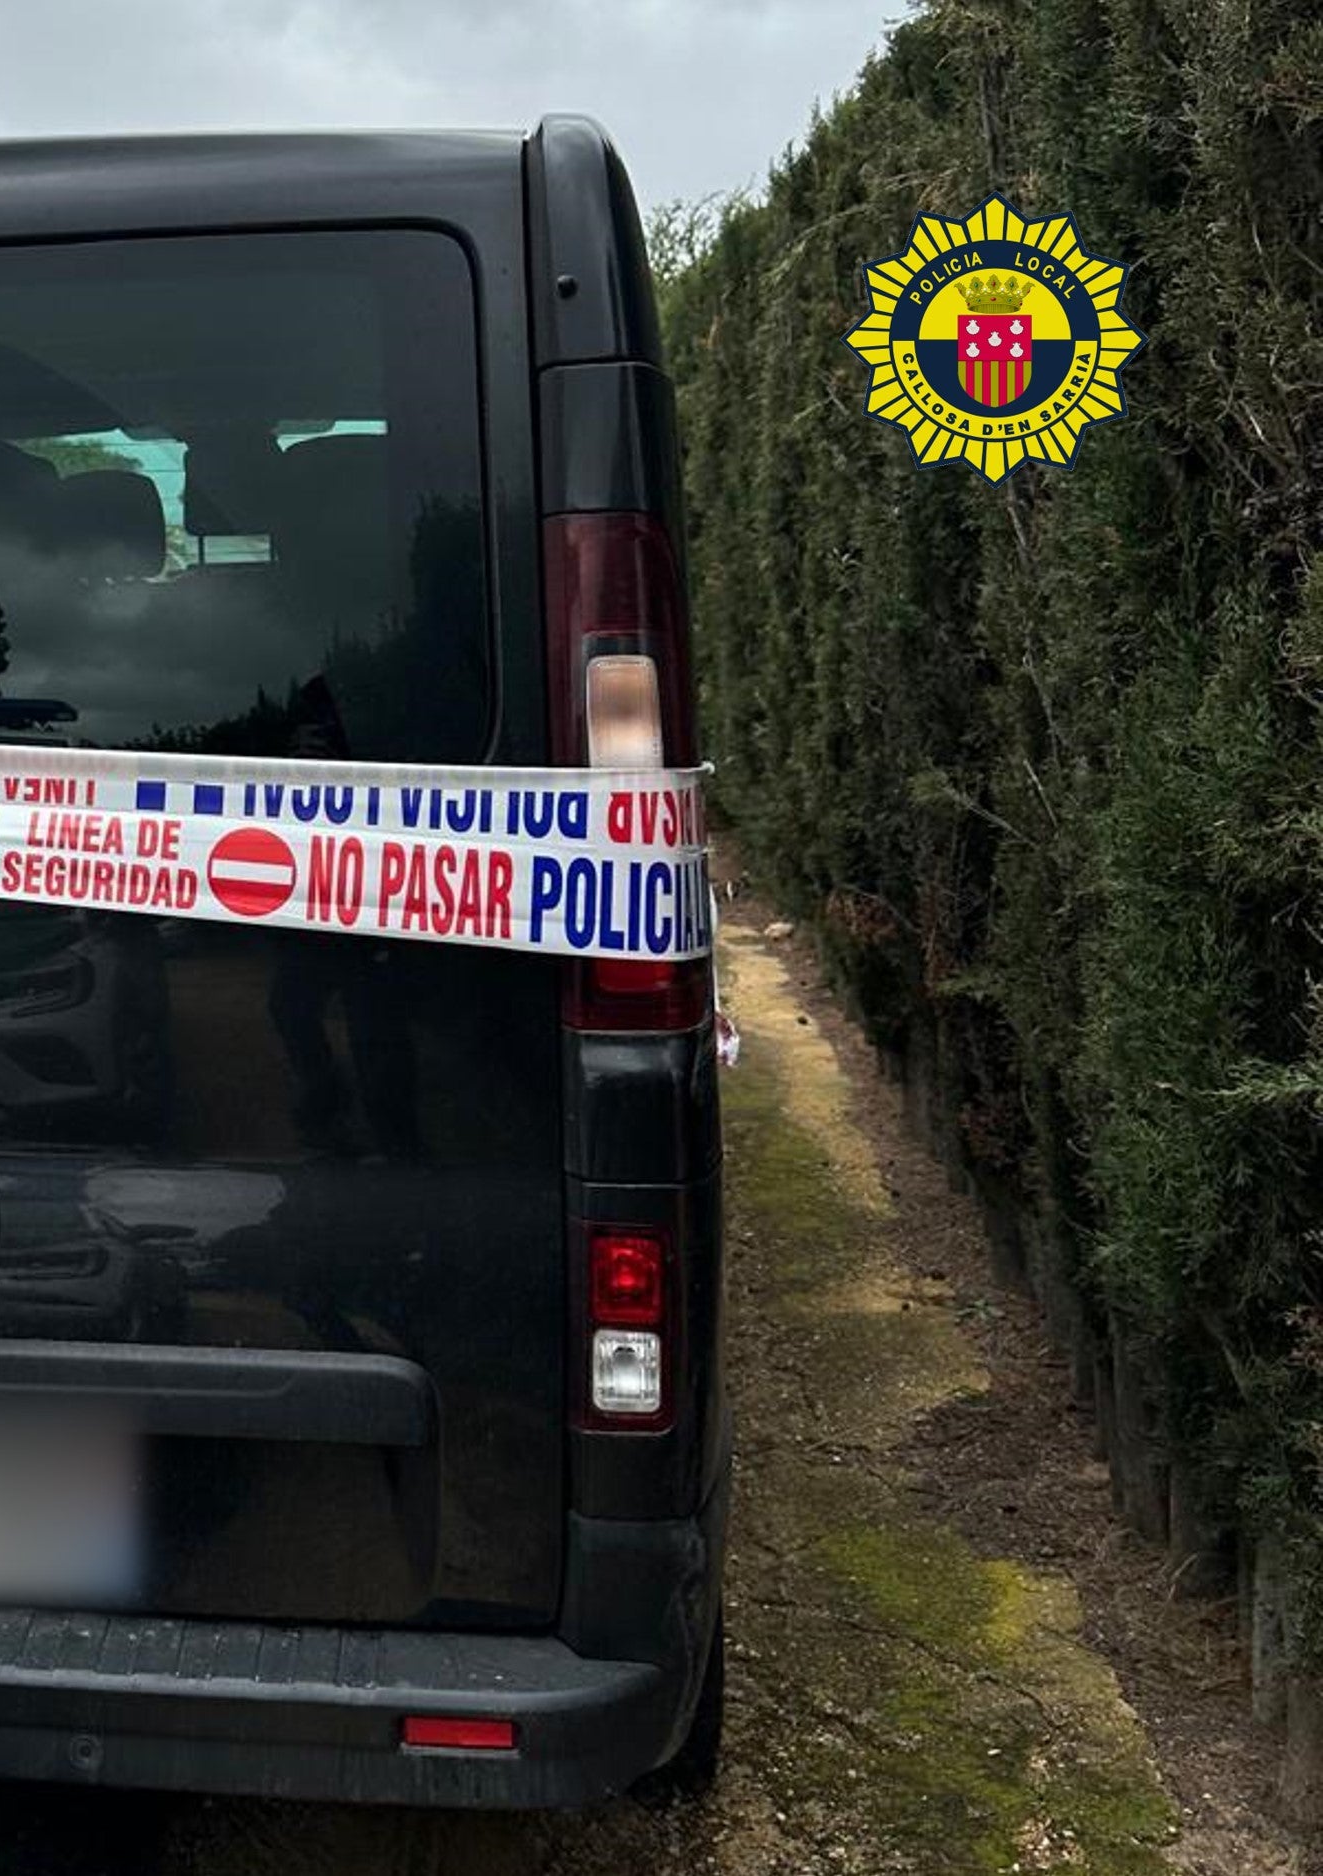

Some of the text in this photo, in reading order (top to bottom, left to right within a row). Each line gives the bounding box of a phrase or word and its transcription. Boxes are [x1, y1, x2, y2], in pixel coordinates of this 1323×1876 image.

[26, 811, 181, 861] LINEA DE
[1, 850, 198, 911] SEGURIDAD
[306, 835, 364, 928] NO
[379, 842, 514, 939] PASAR
